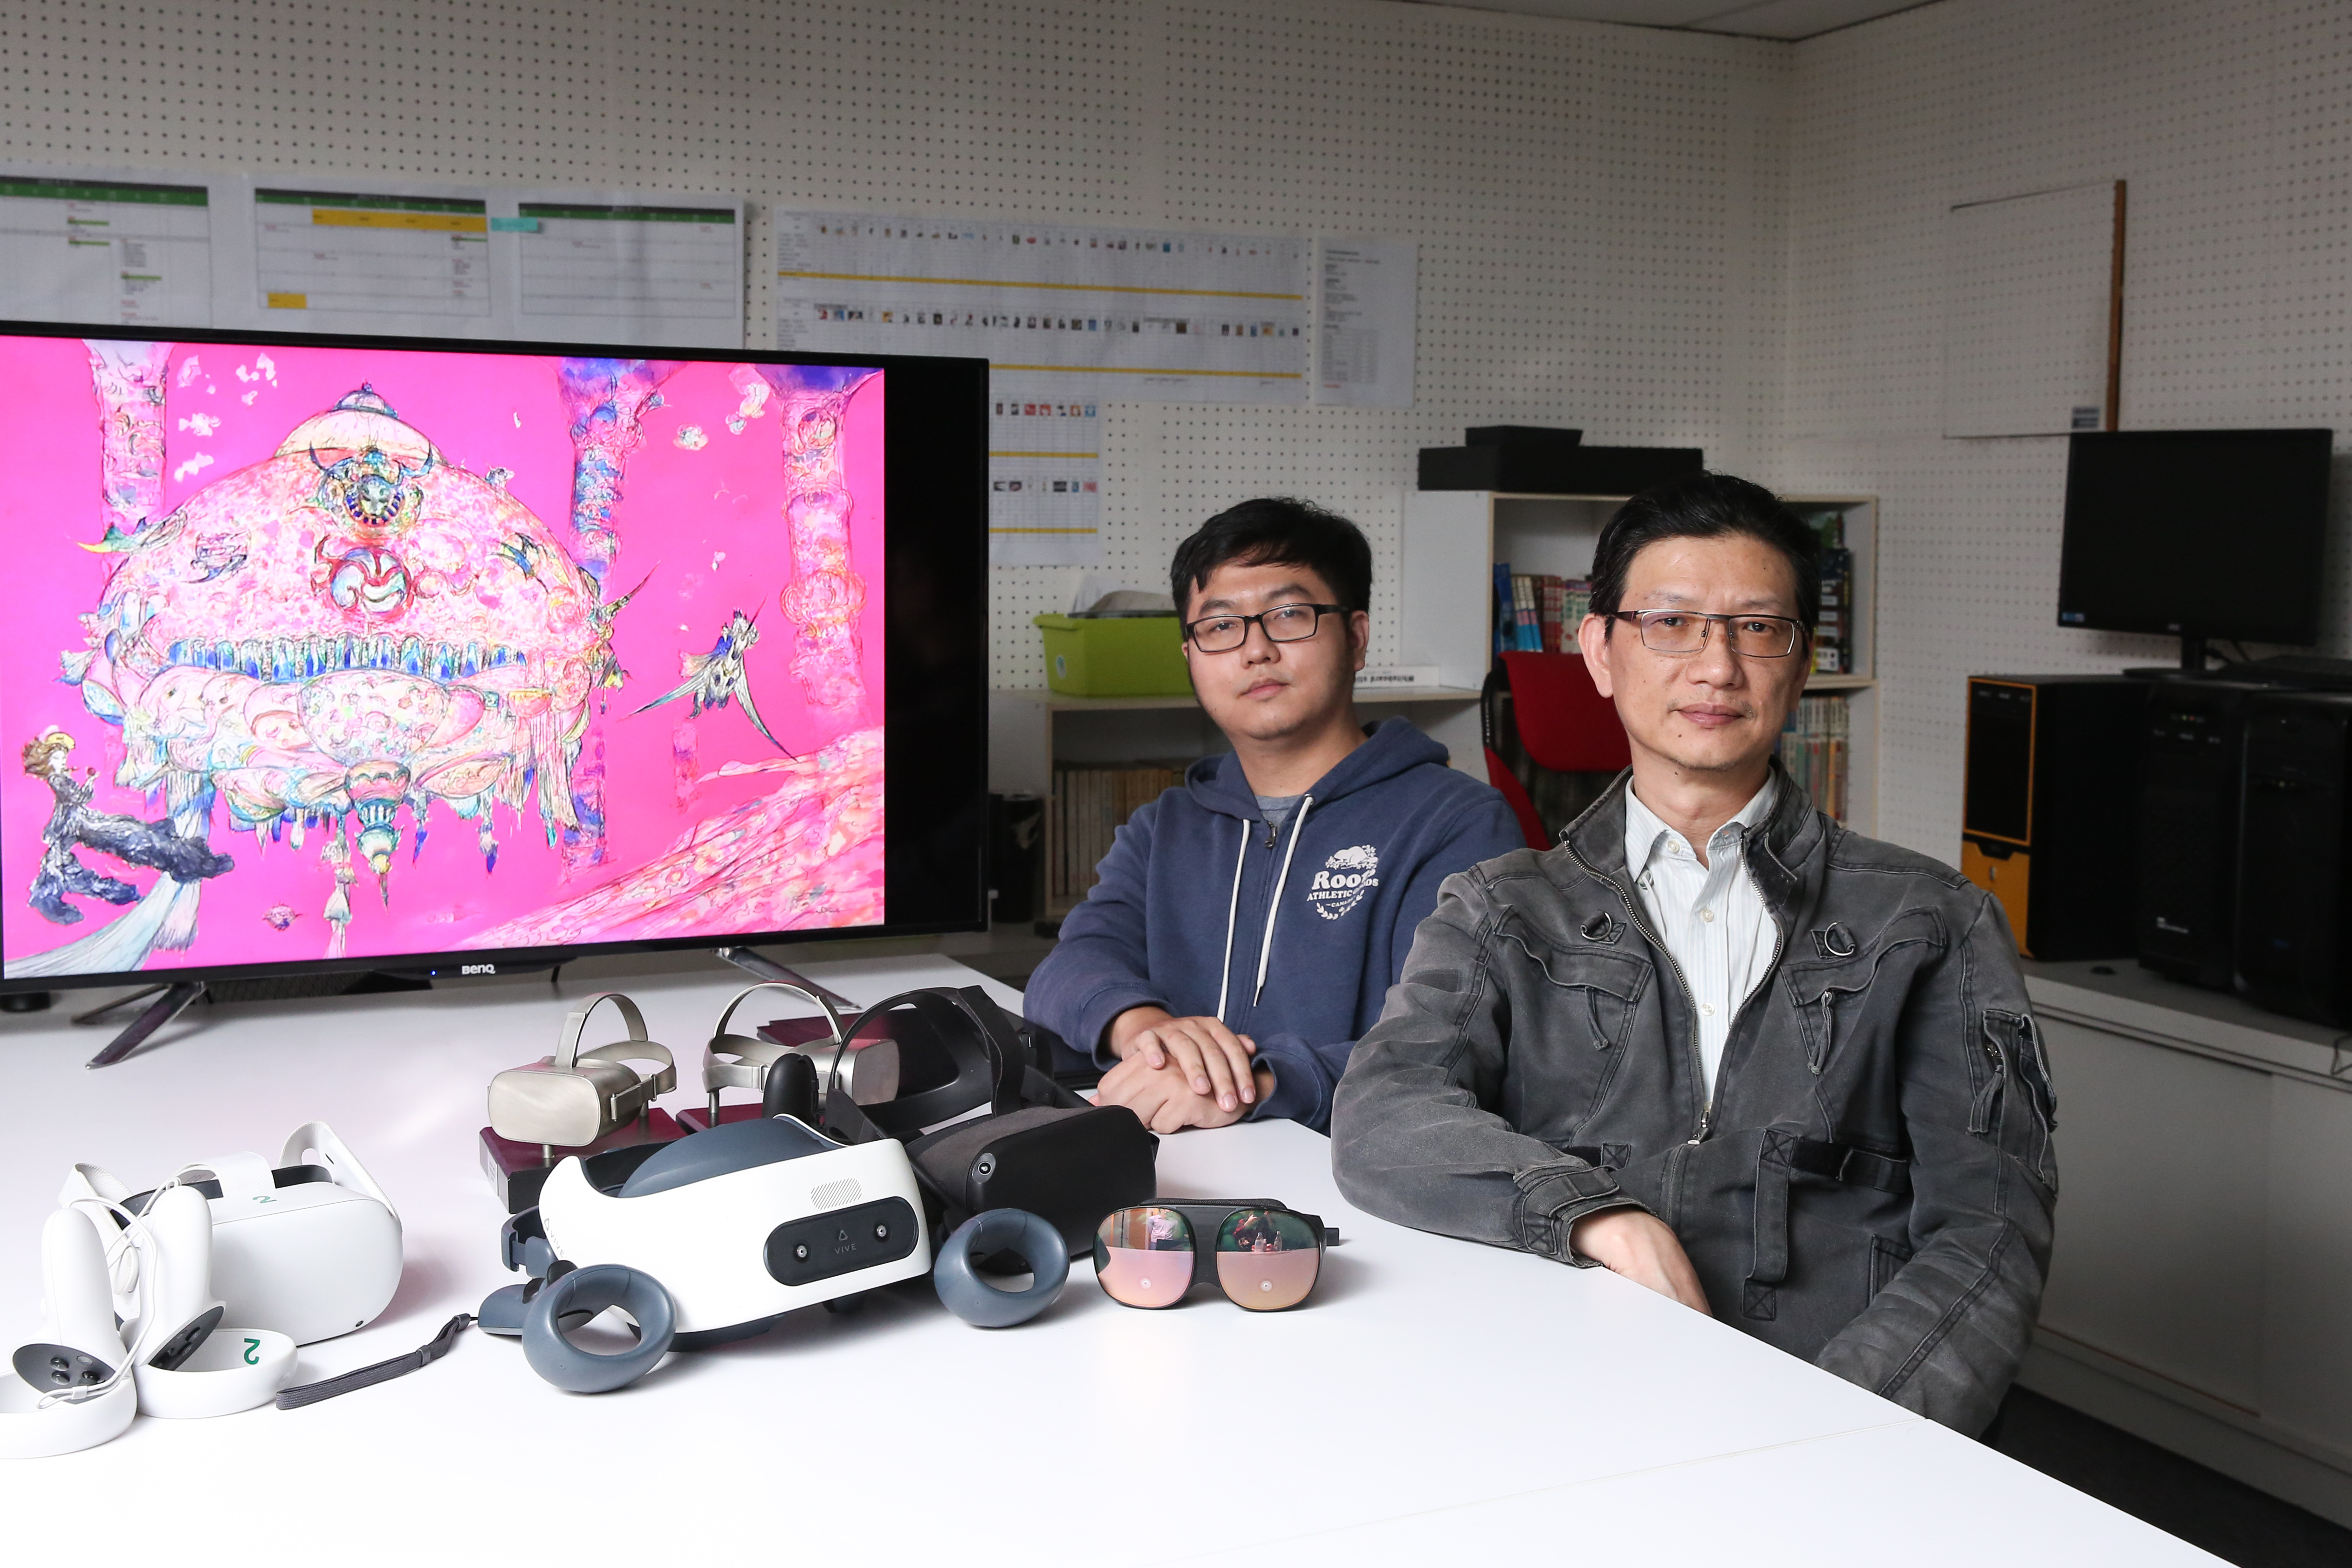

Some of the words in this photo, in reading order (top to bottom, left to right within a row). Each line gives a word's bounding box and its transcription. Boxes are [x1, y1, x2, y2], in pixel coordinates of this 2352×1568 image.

[1307, 890, 1353, 901] ATHLETIC
[461, 964, 495, 975] BenQ
[551, 1229, 564, 1259] VIVE
[834, 1243, 856, 1254] VIVE
[244, 1338, 261, 1365] 2
